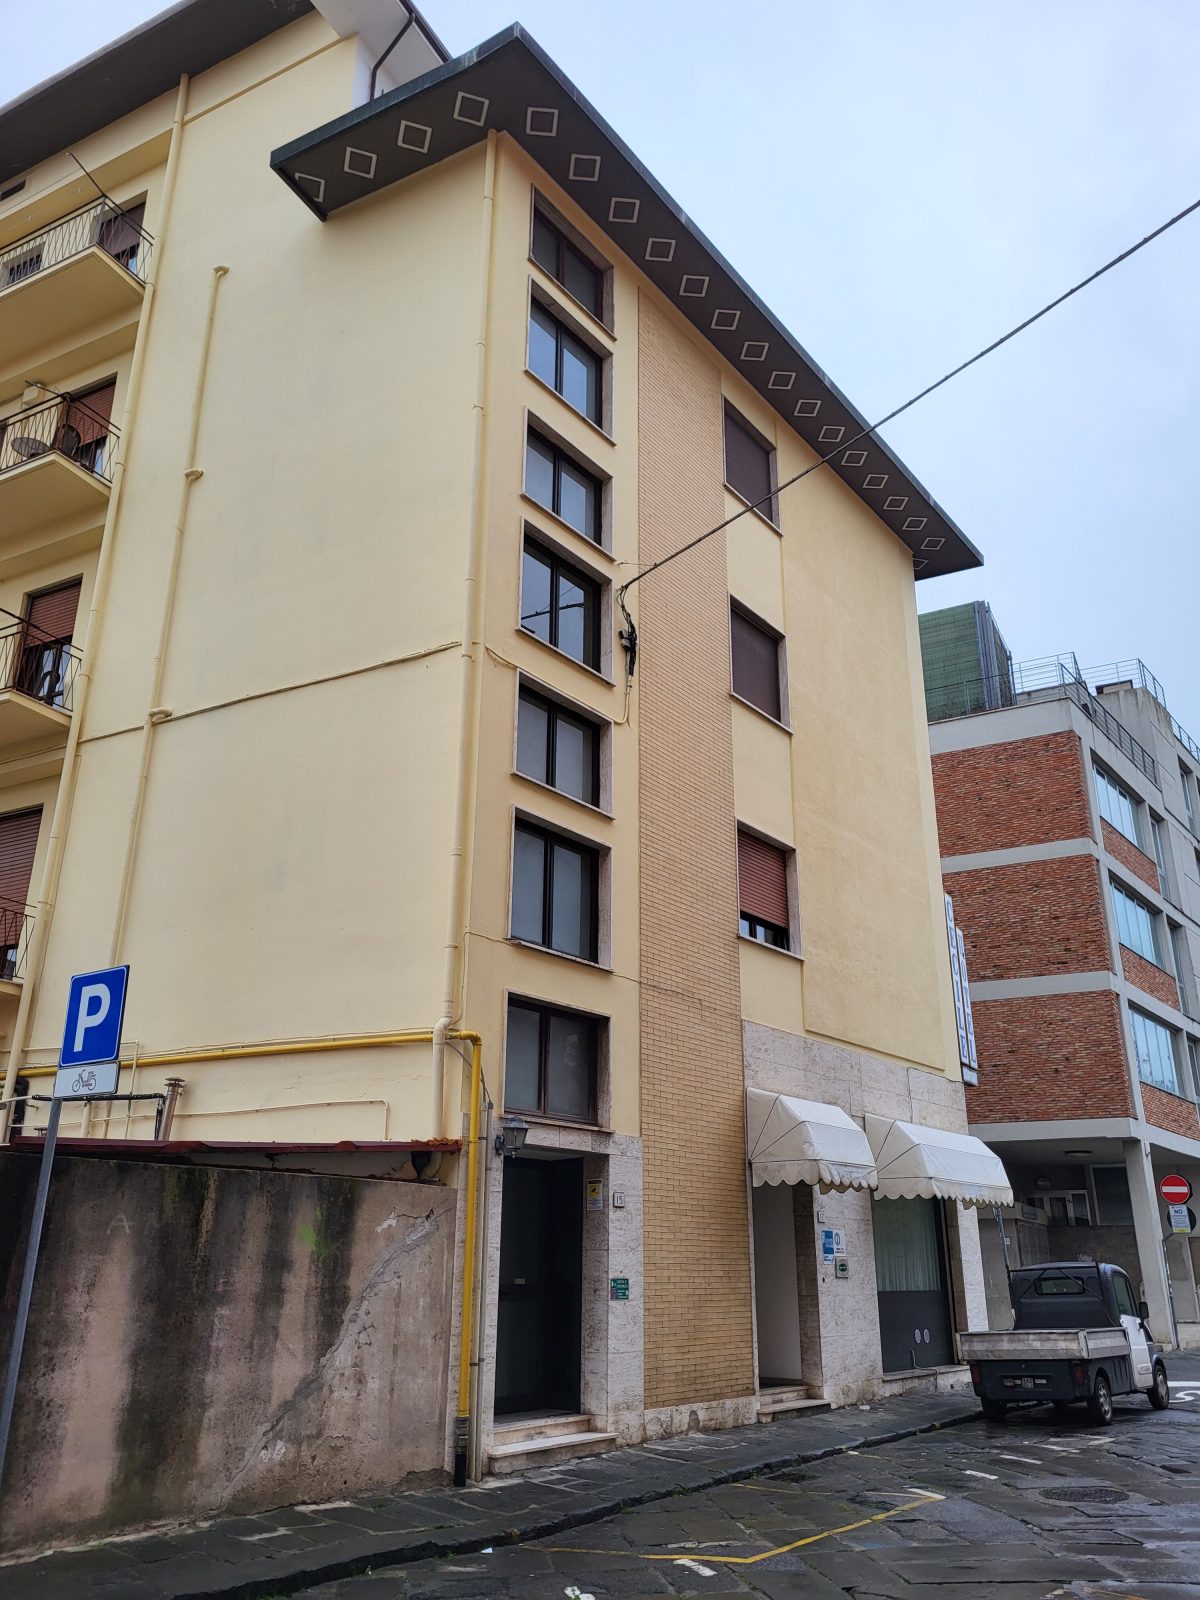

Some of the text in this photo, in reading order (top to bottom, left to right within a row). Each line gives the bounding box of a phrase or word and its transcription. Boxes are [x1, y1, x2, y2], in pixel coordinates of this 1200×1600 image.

[74, 983, 110, 1052] P
[947, 900, 967, 1060] CECILE
[958, 934, 977, 1062] HOTEL
